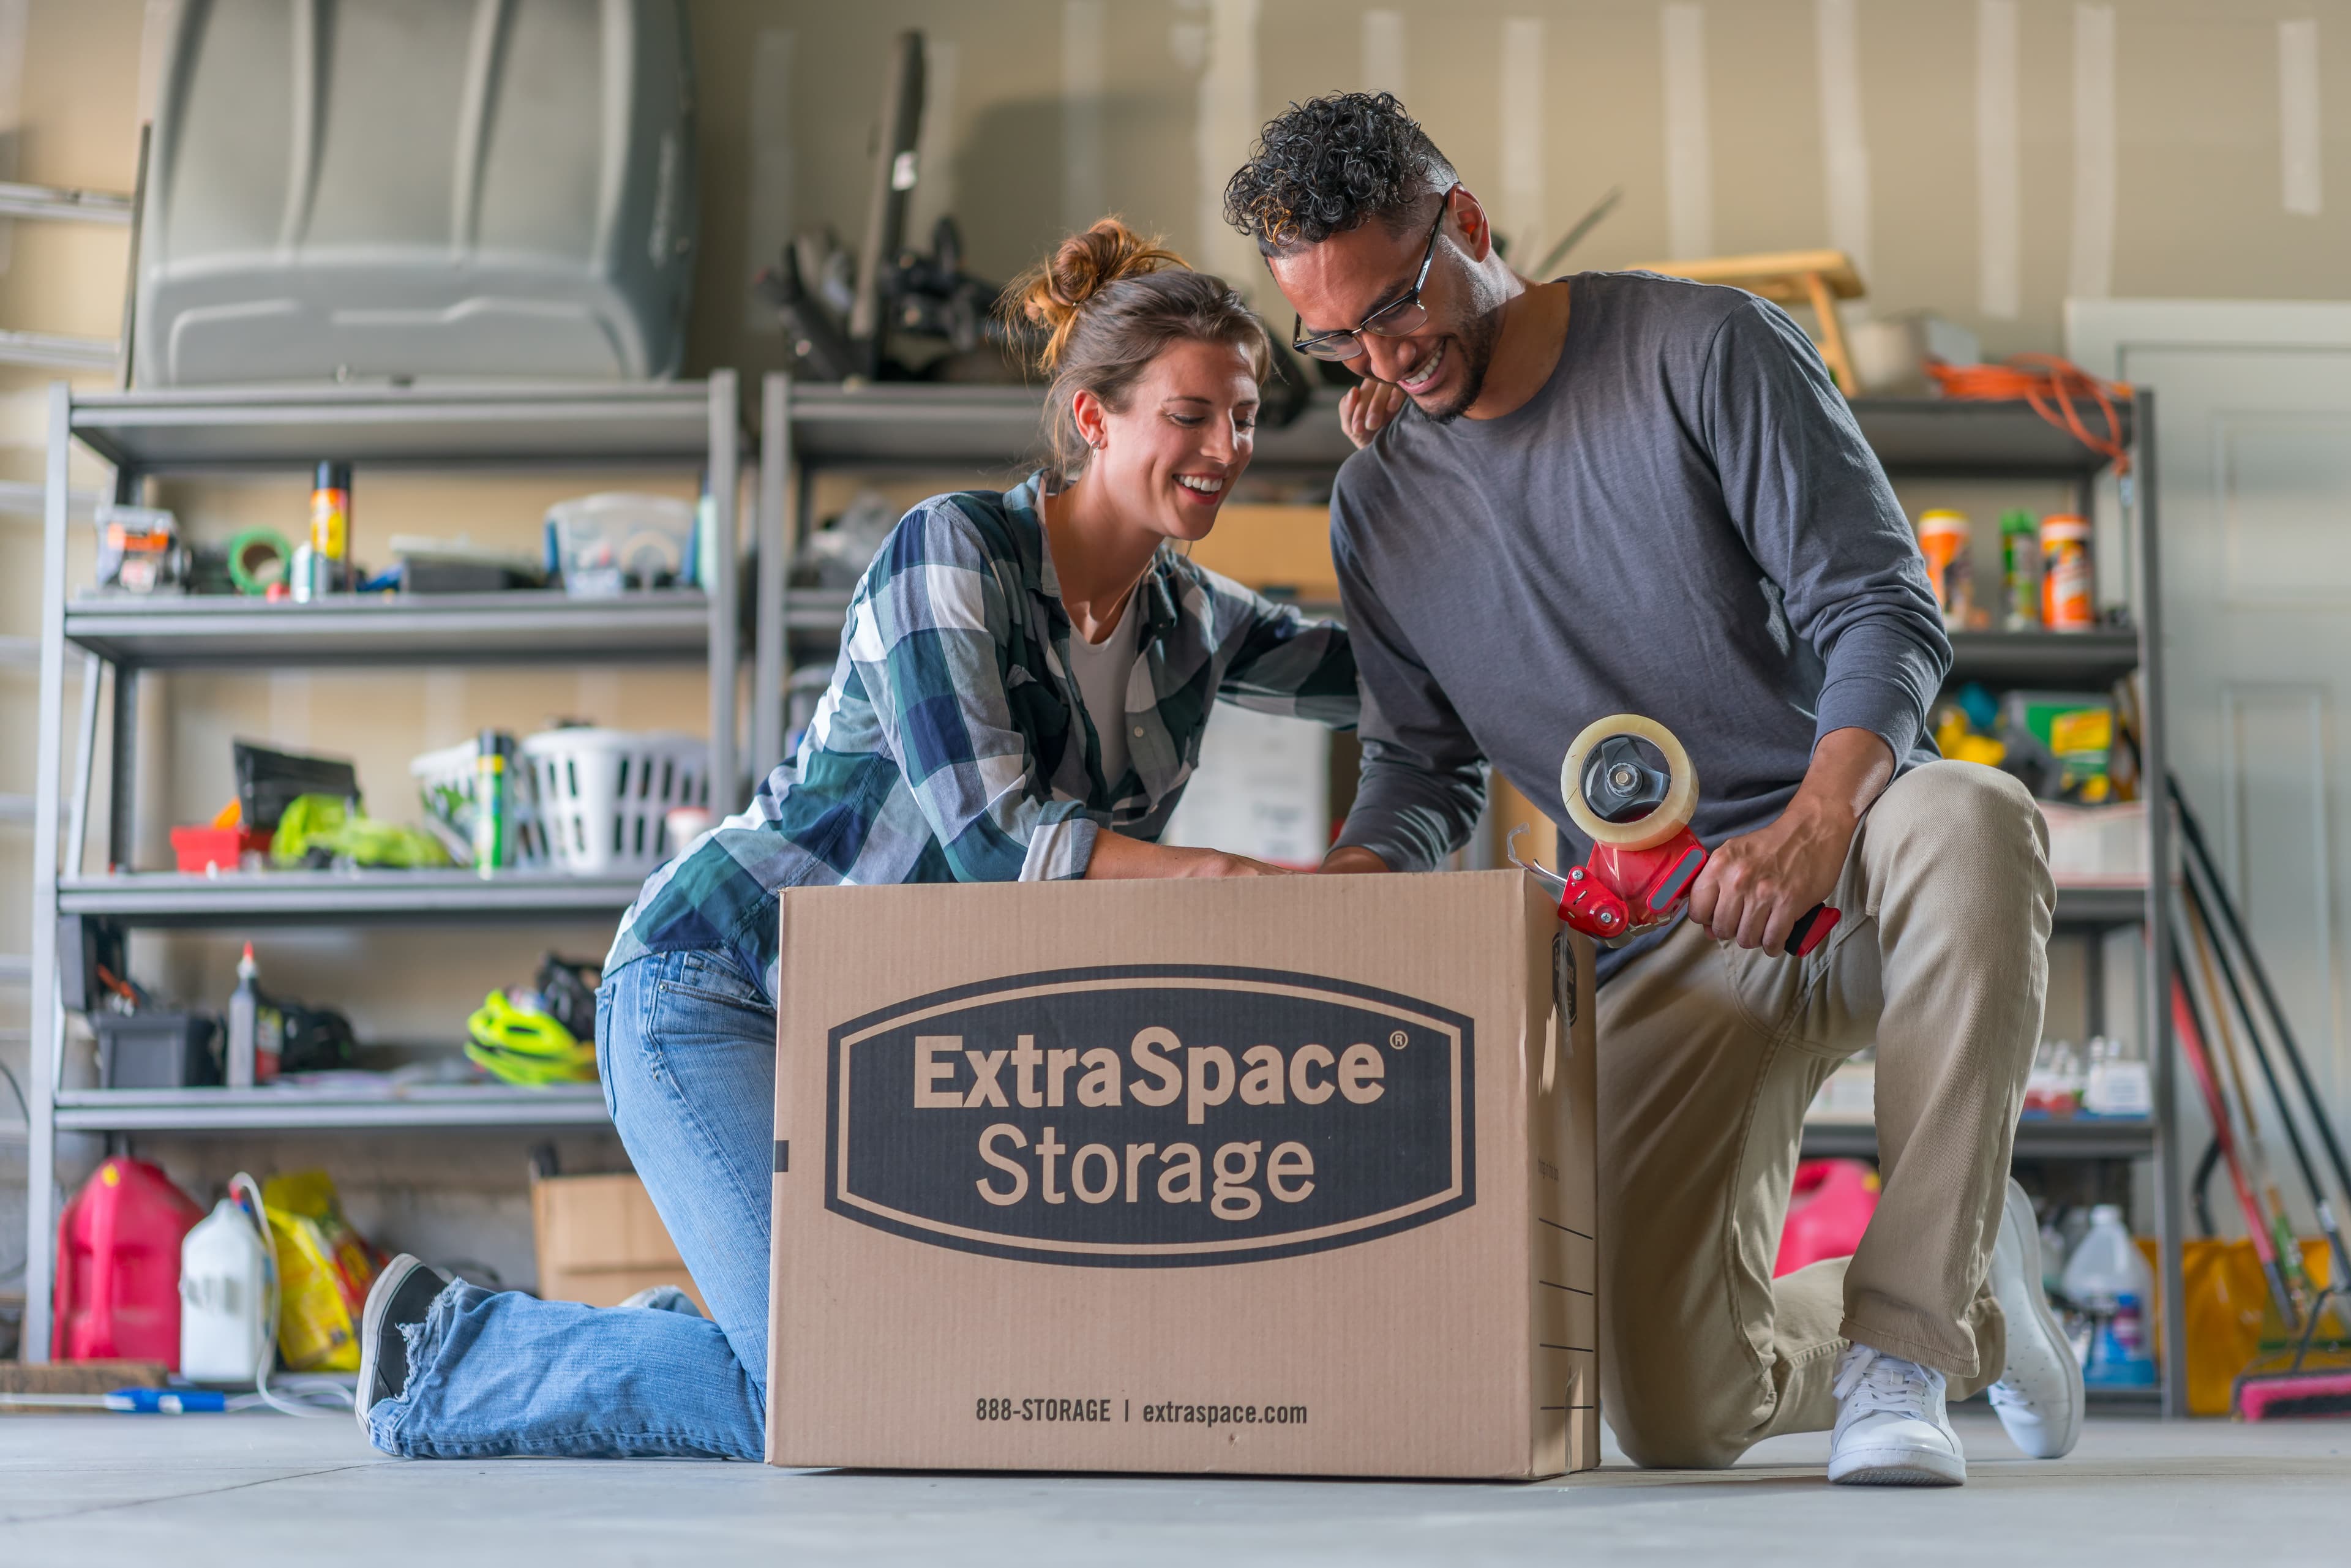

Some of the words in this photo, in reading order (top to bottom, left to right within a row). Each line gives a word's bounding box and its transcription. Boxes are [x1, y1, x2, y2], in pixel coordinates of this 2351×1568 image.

[975, 1123, 1315, 1221] Storage
[976, 1398, 1111, 1422] 888-STORAGE
[1143, 1401, 1307, 1428] extraspace.com
